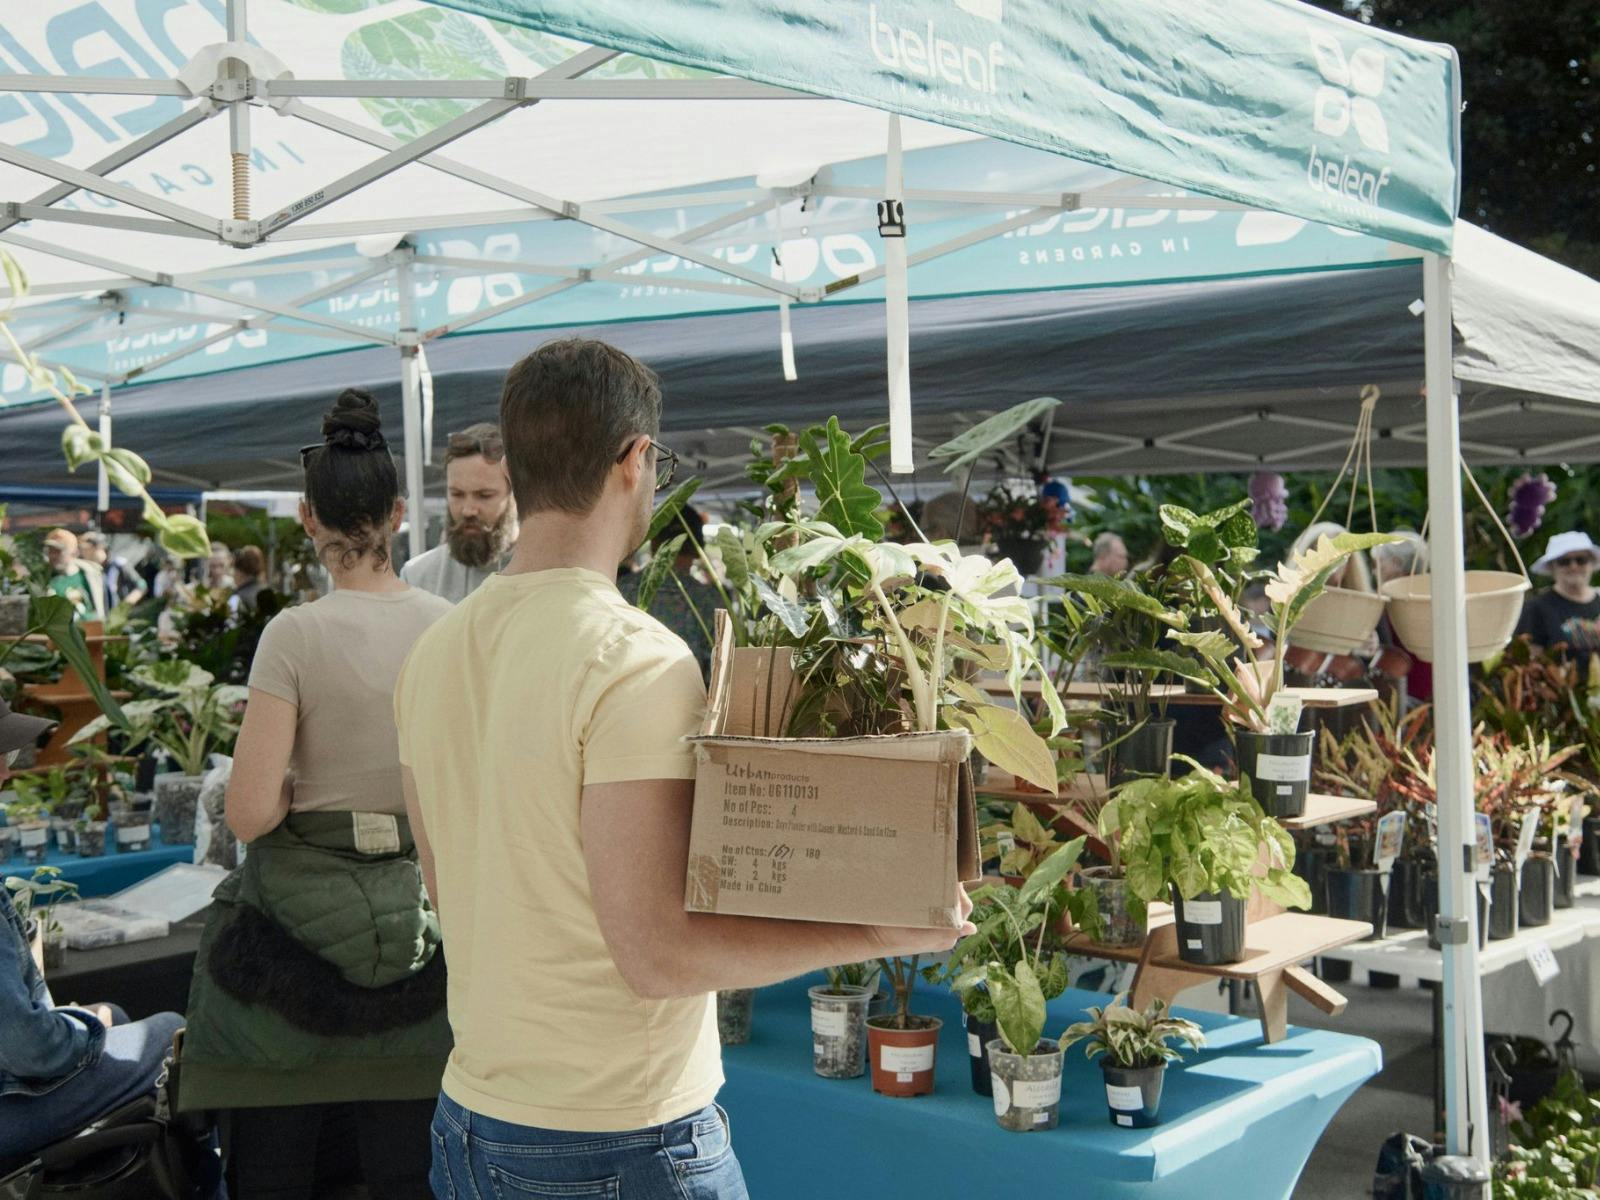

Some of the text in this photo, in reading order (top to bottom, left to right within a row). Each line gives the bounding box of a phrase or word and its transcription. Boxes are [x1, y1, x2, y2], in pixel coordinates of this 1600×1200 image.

[869, 3, 1005, 94] beleaf
[1308, 144, 1391, 207] beleaf
[724, 781, 747, 796] Item
[749, 783, 766, 797] No:
[723, 799, 736, 812] No
[739, 800, 748, 813] of
[750, 801, 772, 815] Pcs:
[722, 815, 774, 830] Description:
[722, 844, 734, 854] No
[735, 845, 744, 855] of
[752, 858, 759, 868] 4
[720, 867, 736, 879] NW:
[752, 870, 759, 880] 2
[720, 879, 782, 894] Made in China
